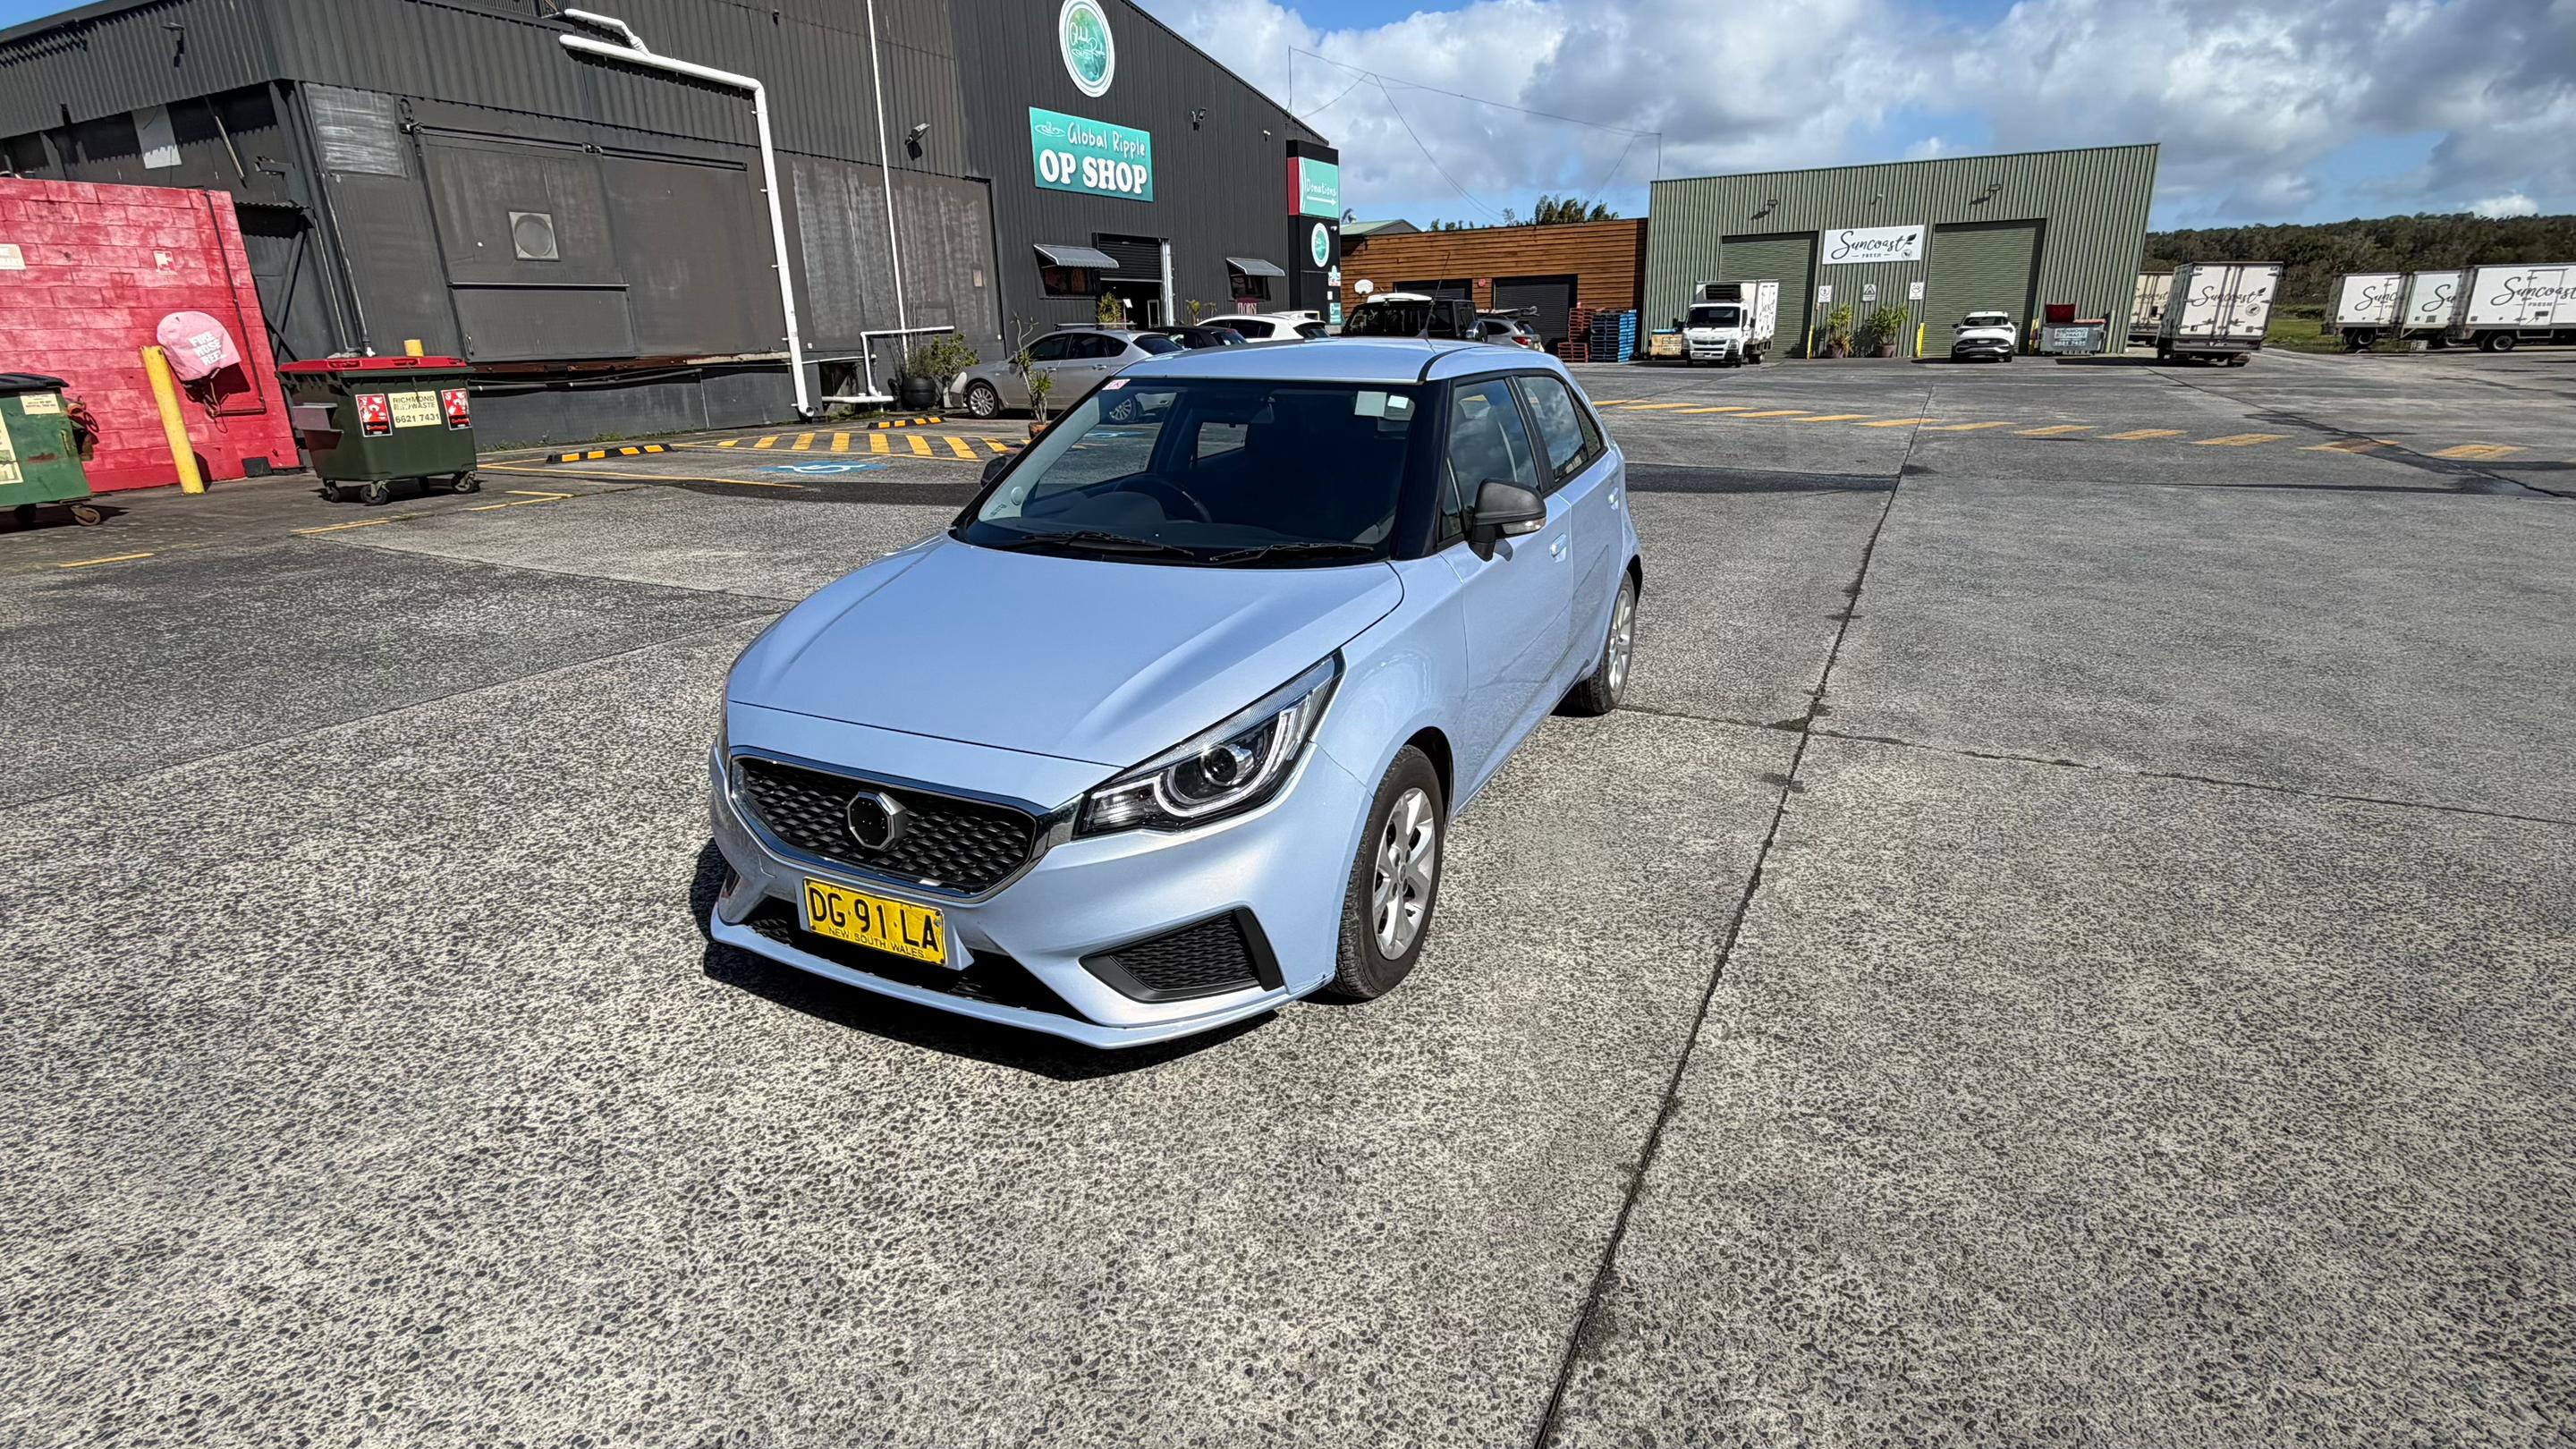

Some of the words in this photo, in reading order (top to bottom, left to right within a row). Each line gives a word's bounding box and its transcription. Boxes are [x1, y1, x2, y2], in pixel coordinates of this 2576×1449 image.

[1068, 122, 1108, 149] Global
[1113, 131, 1145, 159] Ripple
[1039, 148, 1076, 184] OP
[1082, 156, 1147, 194] SHOP
[1306, 178, 1337, 197] Donations
[1831, 230, 1905, 259] Suncoast
[394, 395, 435, 403] RICHMOND
[394, 415, 417, 424] 6621
[419, 413, 440, 422] 7431
[809, 887, 846, 928] DG
[854, 899, 887, 939] 91
[900, 909, 940, 952] LA
[828, 925, 851, 940] NEW
[854, 933, 887, 949] SOUTH
[891, 941, 925, 959] WALES
